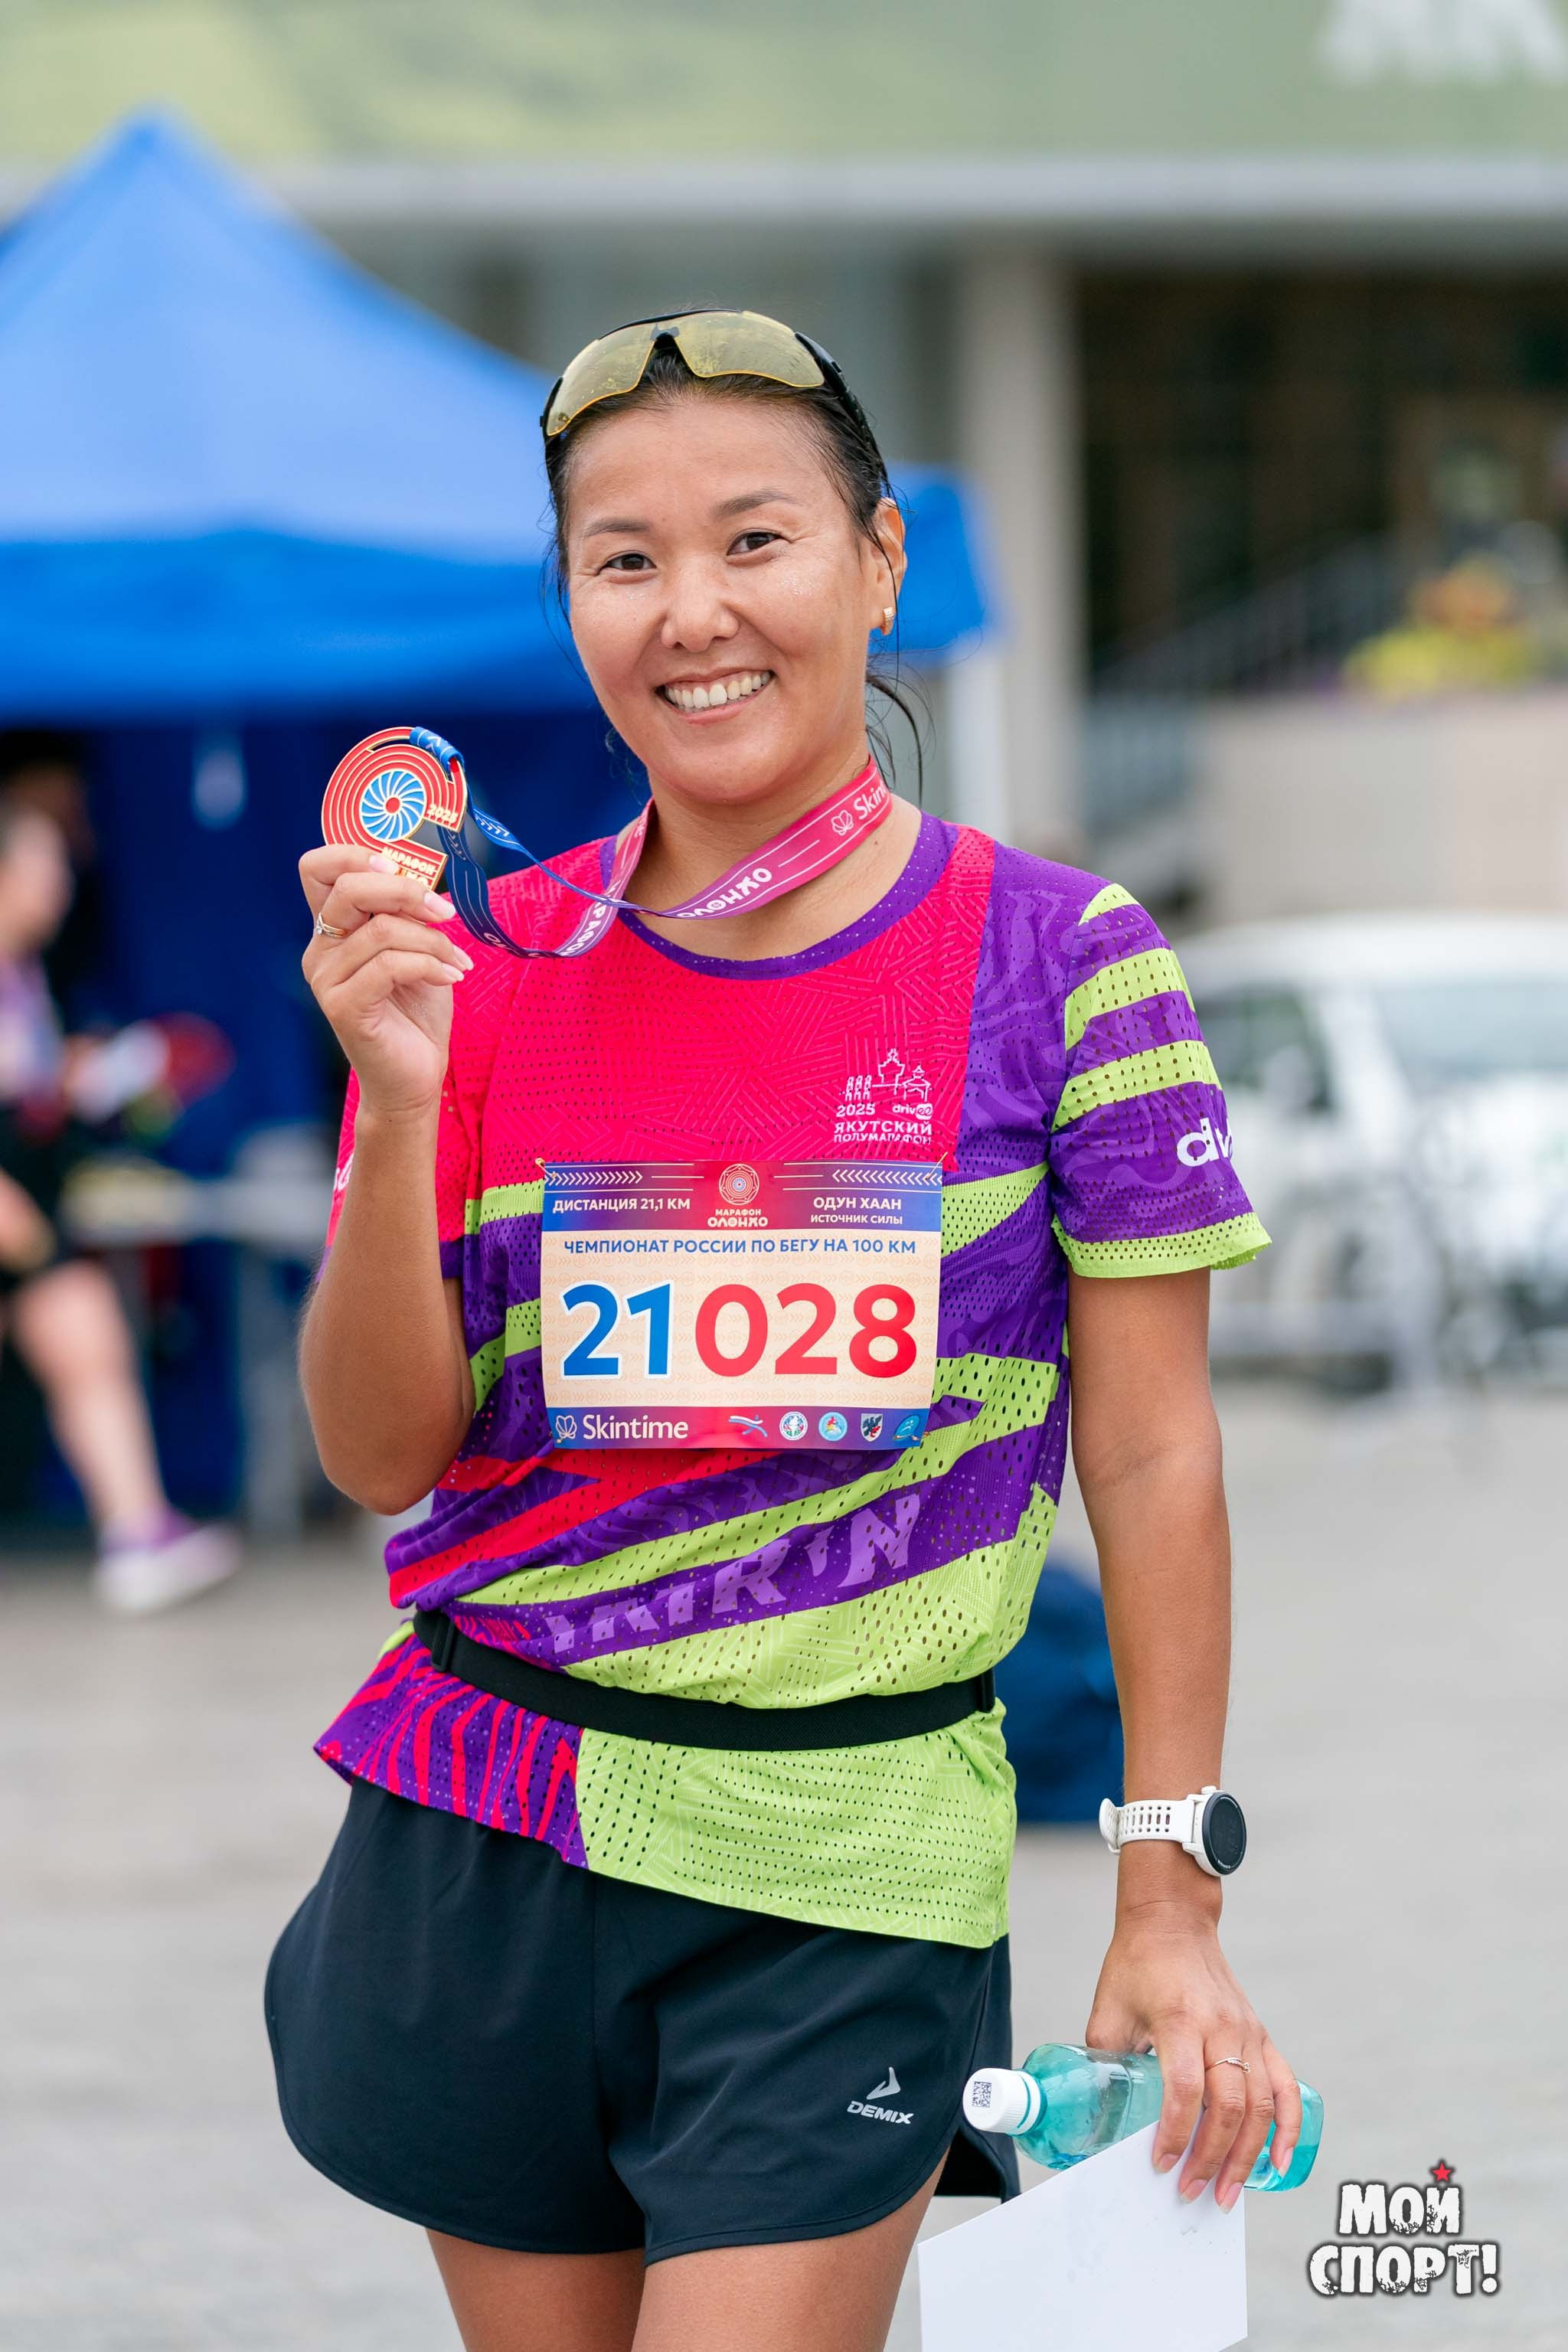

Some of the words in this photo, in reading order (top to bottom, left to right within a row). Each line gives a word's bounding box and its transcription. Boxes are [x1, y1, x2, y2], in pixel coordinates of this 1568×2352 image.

[426, 803, 459, 824] 2025
[836, 1102, 876, 1118] 2025
[834, 1120, 932, 1135] ЯКУТСКИЙ
[834, 1132, 931, 1145] ПОЛУМАРАФОН
[553, 1197, 637, 1214] ДИСТАНЦИЯ
[640, 1197, 665, 1211] 21,1
[667, 1197, 691, 1210] КМ
[812, 1197, 857, 1210] ОДУН
[859, 1197, 902, 1210] ХААН
[715, 1208, 762, 1217] МАРАФОН
[810, 1214, 868, 1223] ИСТОЧНИК
[870, 1215, 903, 1225] СИЛЫ
[564, 1240, 669, 1254] ЧЕМПИОНАТ
[673, 1240, 746, 1253] РОССИИ
[751, 1240, 776, 1253] ПО
[780, 1239, 819, 1253] БЕГУ
[824, 1239, 848, 1253] НА
[852, 1239, 884, 1253] 100
[888, 1240, 916, 1254] КМ
[583, 1414, 689, 1440] Skintime
[846, 2100, 914, 2125] DEMIX
